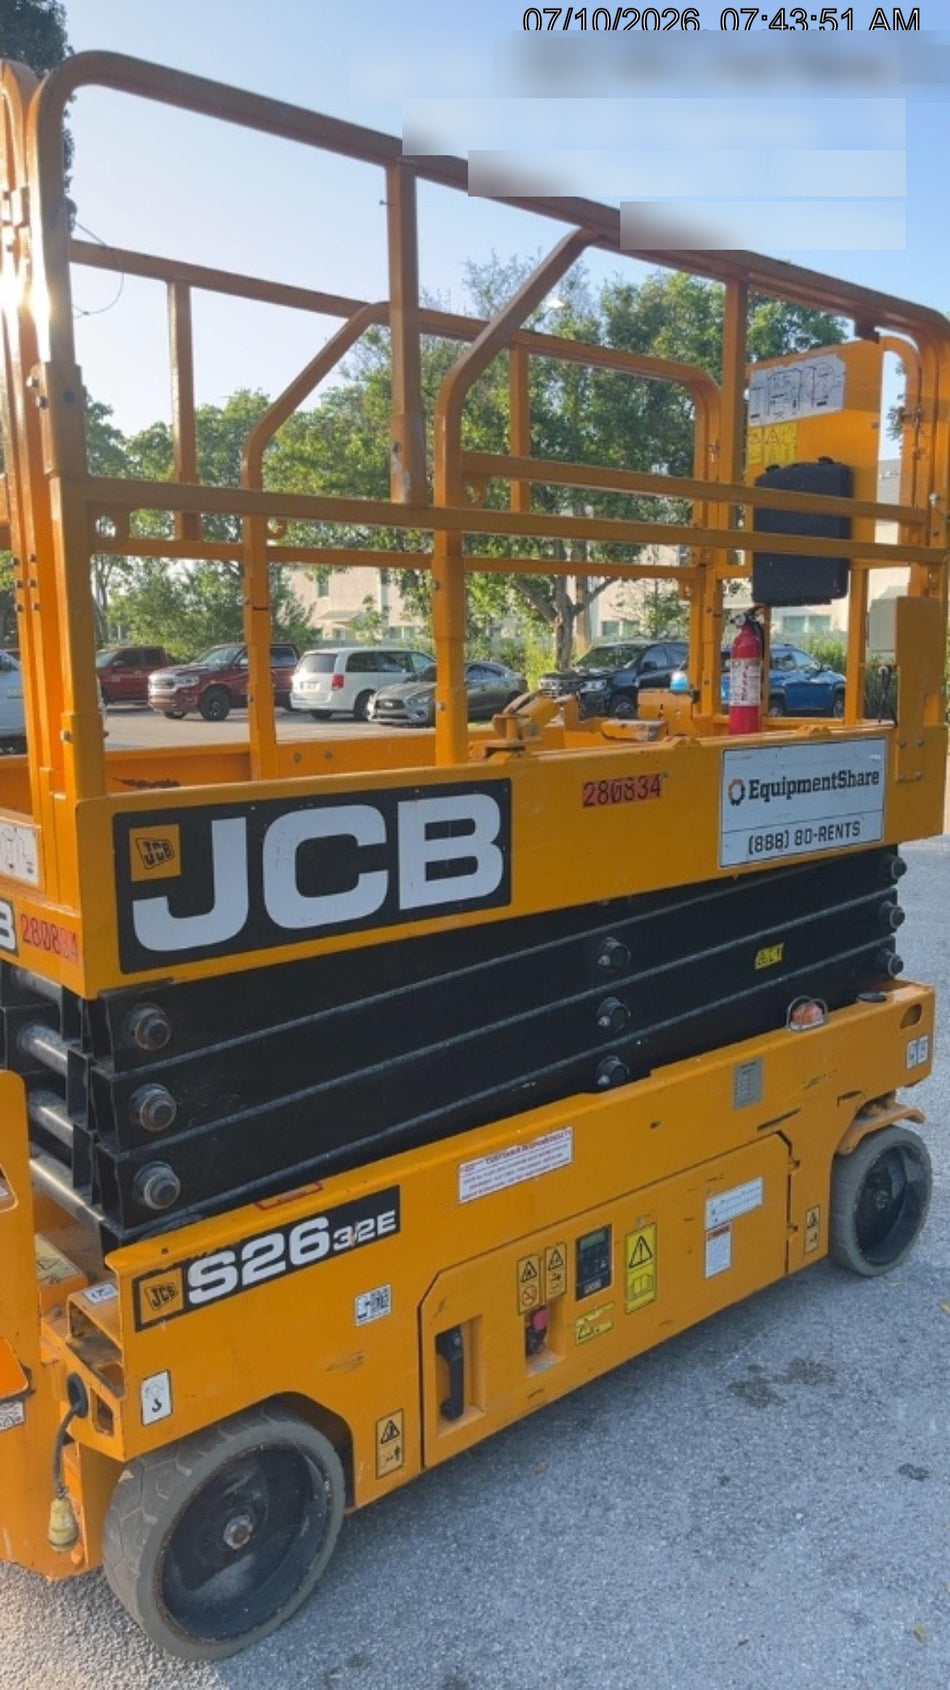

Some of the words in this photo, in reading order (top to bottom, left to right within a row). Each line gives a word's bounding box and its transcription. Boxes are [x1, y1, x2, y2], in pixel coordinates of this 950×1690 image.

[583, 773, 661, 807] 280834
[748, 770, 880, 802] EquipmentShare
[140, 840, 173, 866] JCB
[748, 829, 790, 854] (888)
[794, 820, 861, 846] 80-RENTS
[132, 793, 504, 951] JCB
